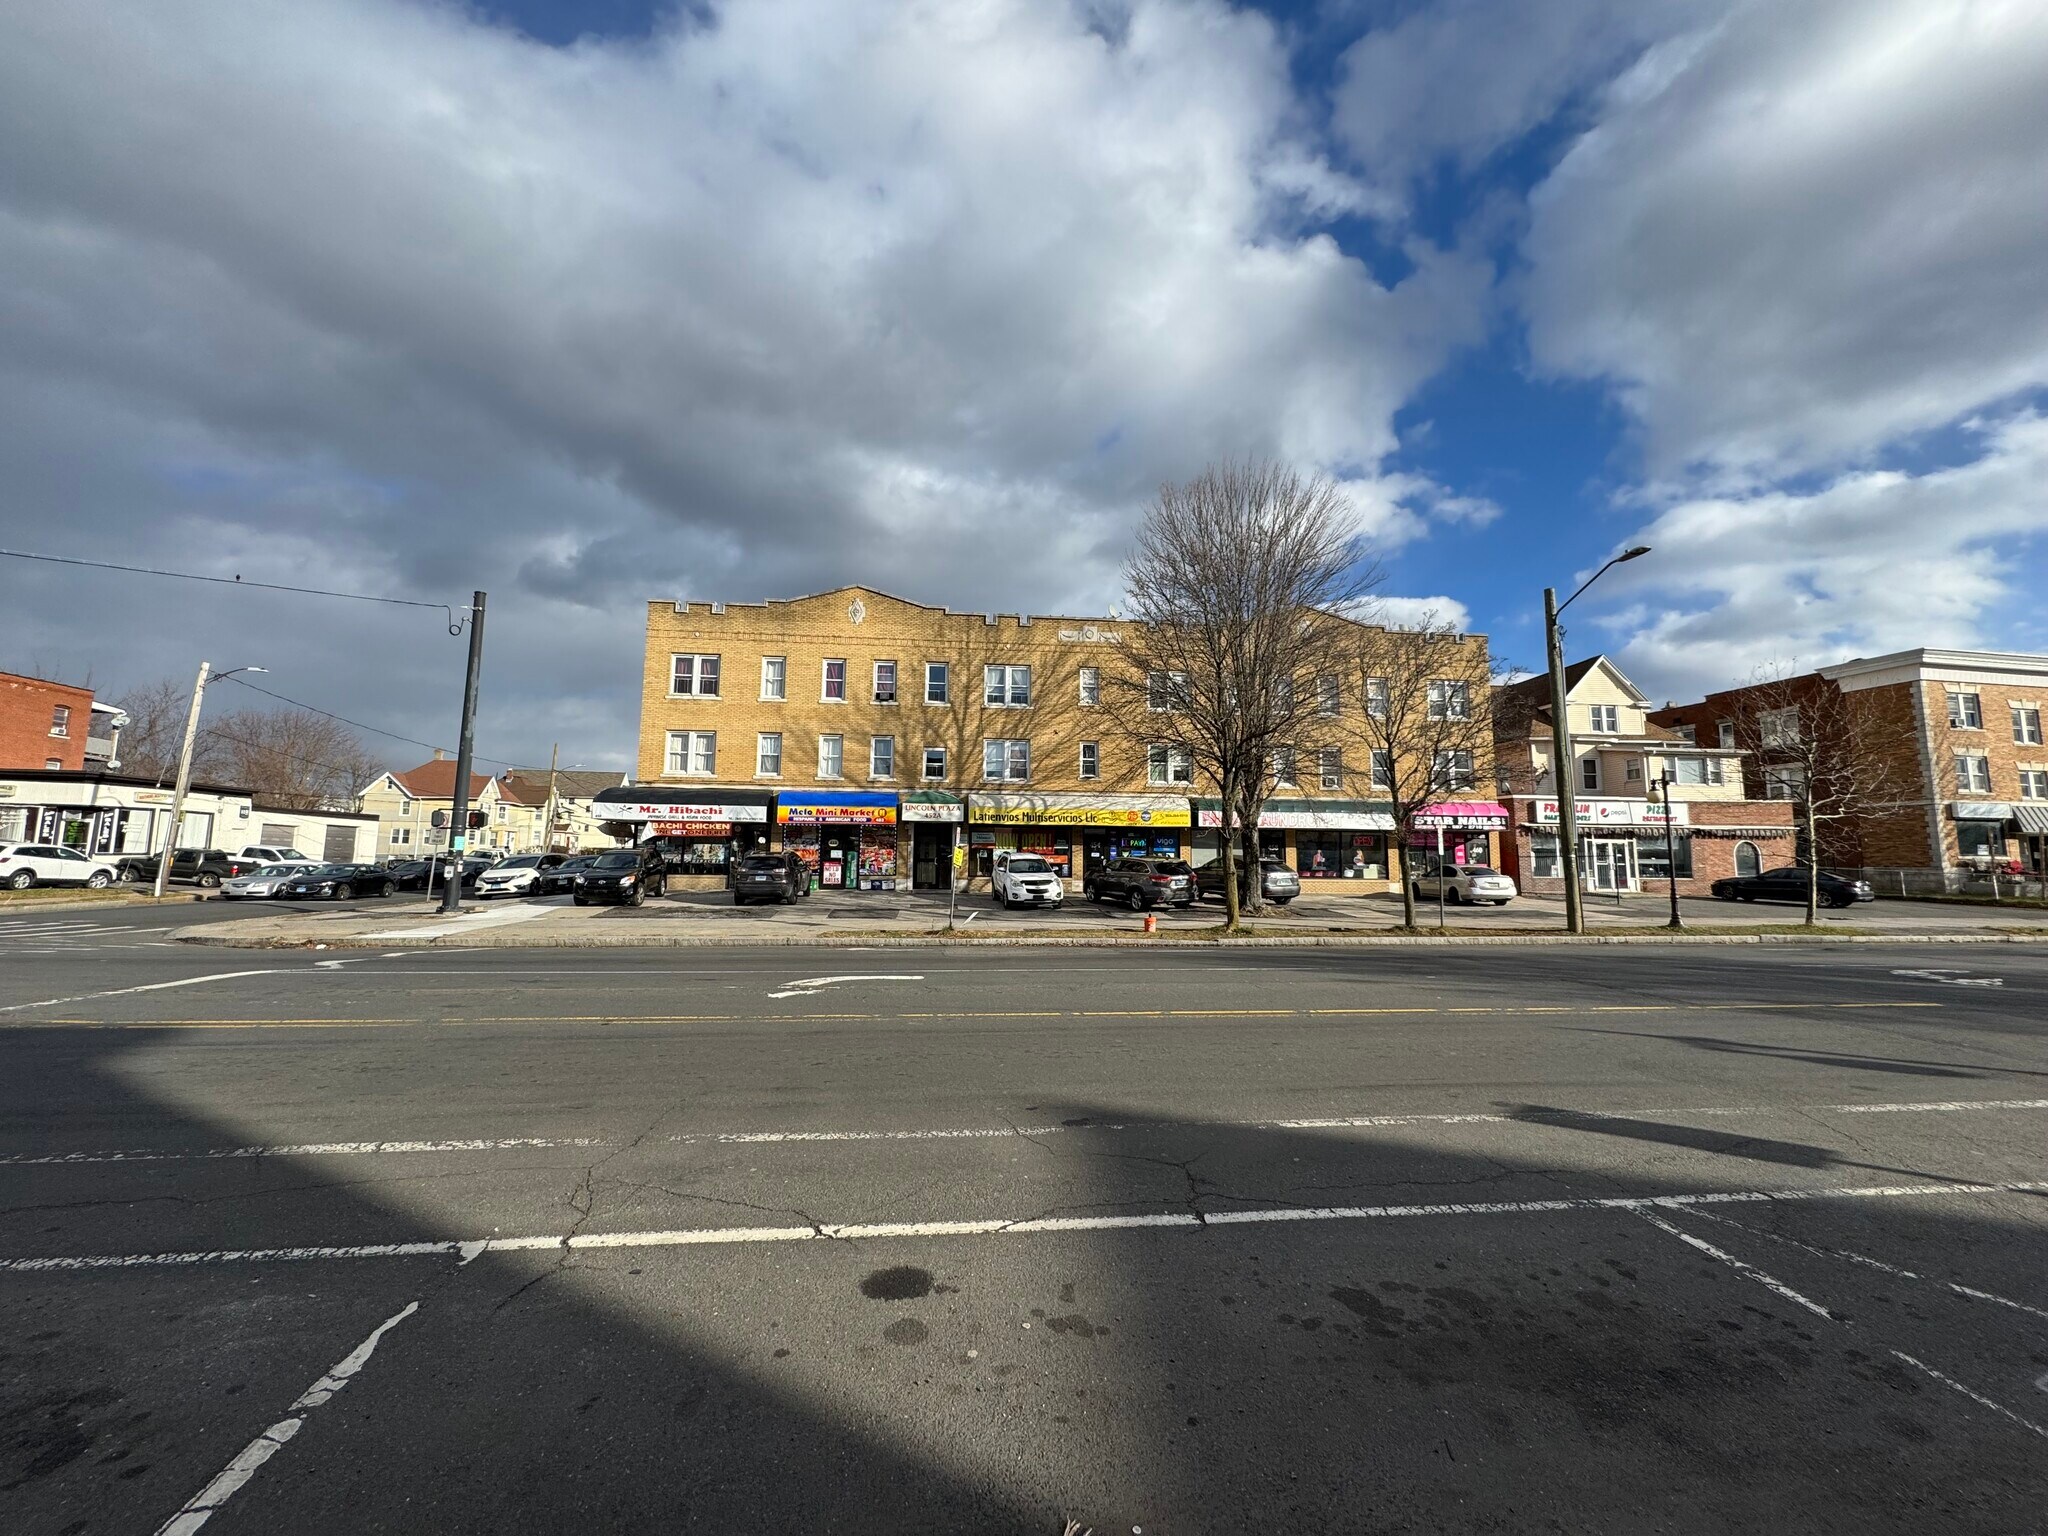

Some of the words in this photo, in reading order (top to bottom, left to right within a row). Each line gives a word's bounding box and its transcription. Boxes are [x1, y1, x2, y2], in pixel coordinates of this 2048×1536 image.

[639, 805, 661, 813] Mr.
[669, 806, 723, 815] Hibachi
[816, 808, 837, 816] Mini
[840, 808, 875, 817] Market
[1544, 803, 1590, 813] FRLIN
[973, 810, 1019, 822] Latienvios
[1022, 811, 1083, 823] Multiservicios
[1414, 816, 1454, 825] STAR
[1457, 816, 1502, 825] NAILS
[995, 832, 1018, 849] NOW
[1156, 838, 1174, 846] vigo
[1353, 836, 1373, 846] OPEN
